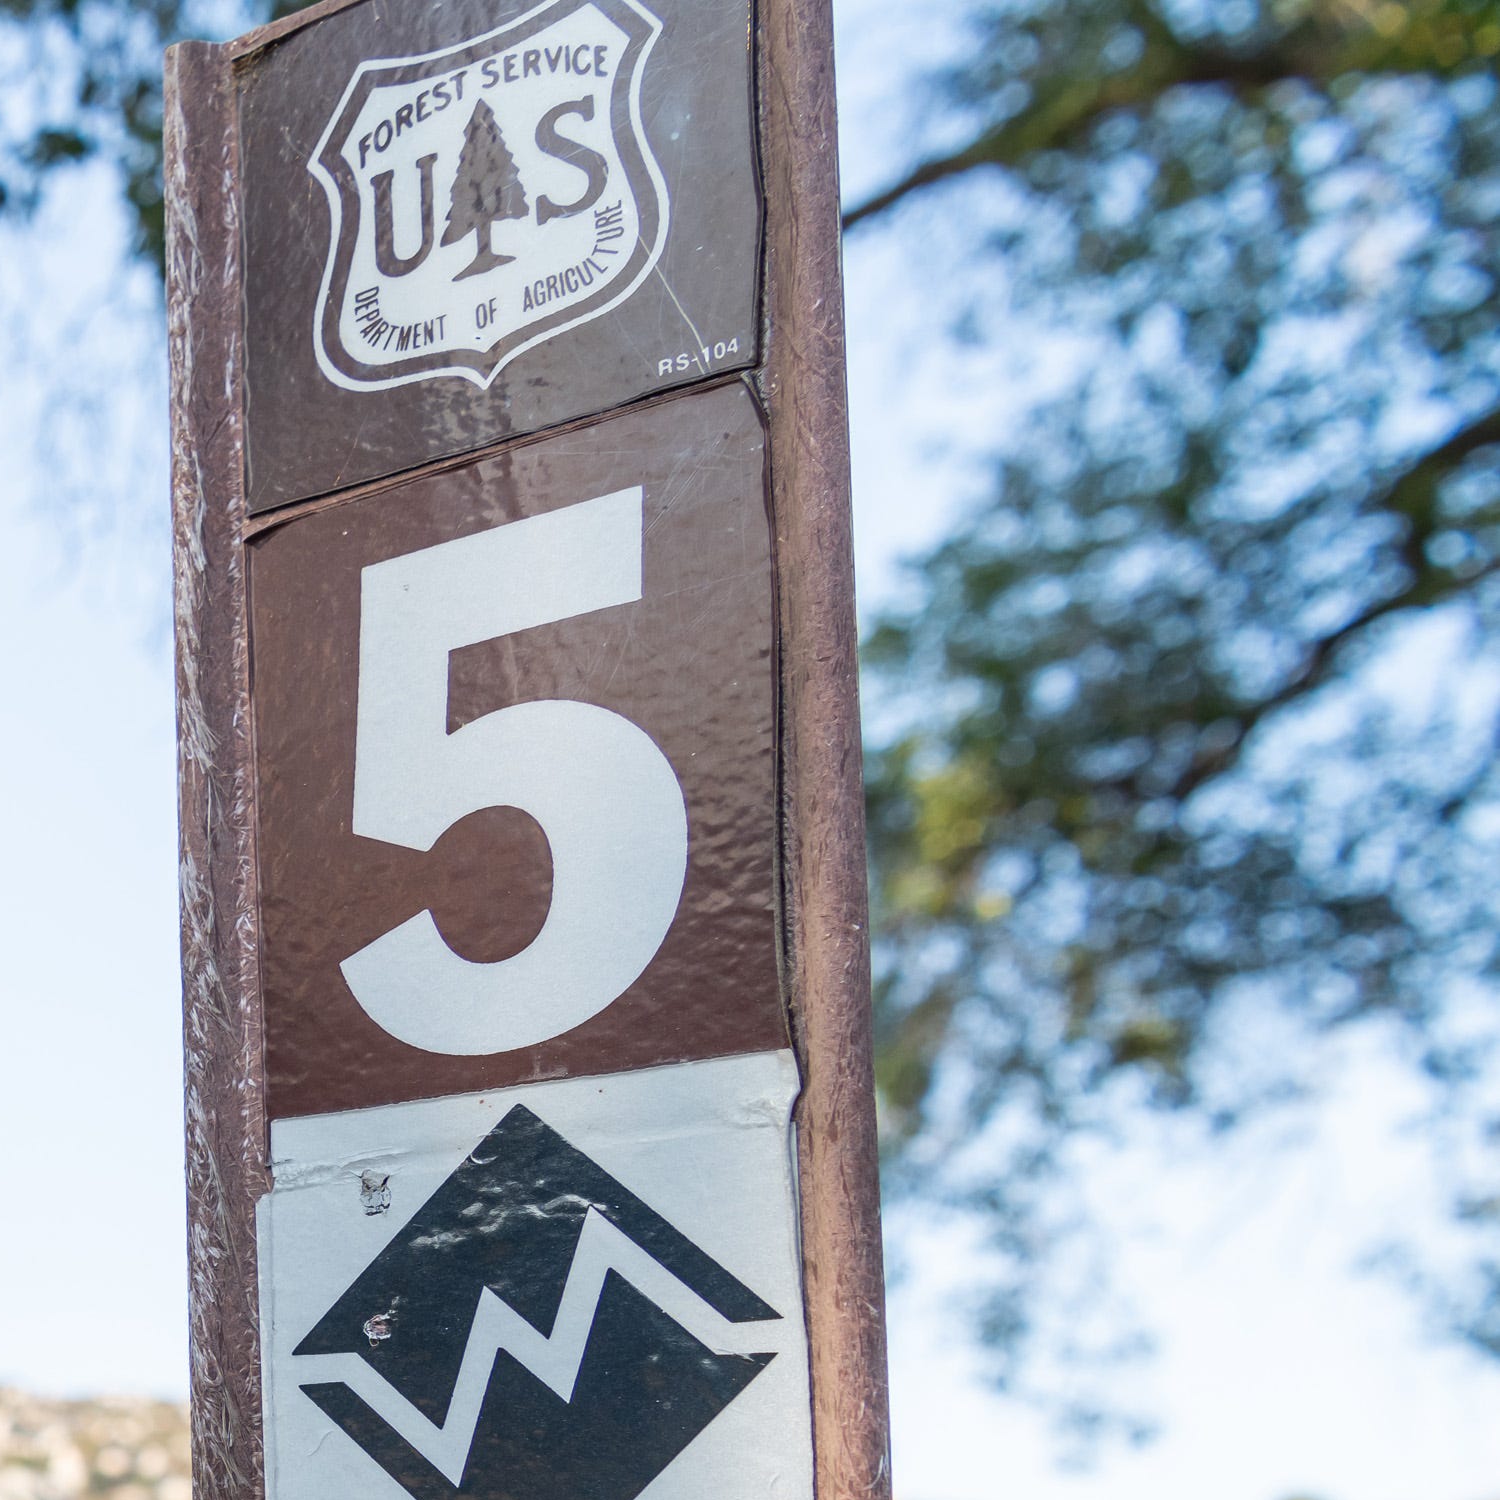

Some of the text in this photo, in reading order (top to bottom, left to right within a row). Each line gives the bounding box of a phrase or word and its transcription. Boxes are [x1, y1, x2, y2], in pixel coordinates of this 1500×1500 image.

[358, 44, 608, 169] FOREST SERVICE
[354, 200, 625, 352] DEPARTMENT OF AGRICULTURE
[657, 337, 739, 377] RS-104
[338, 485, 689, 1057] 5
